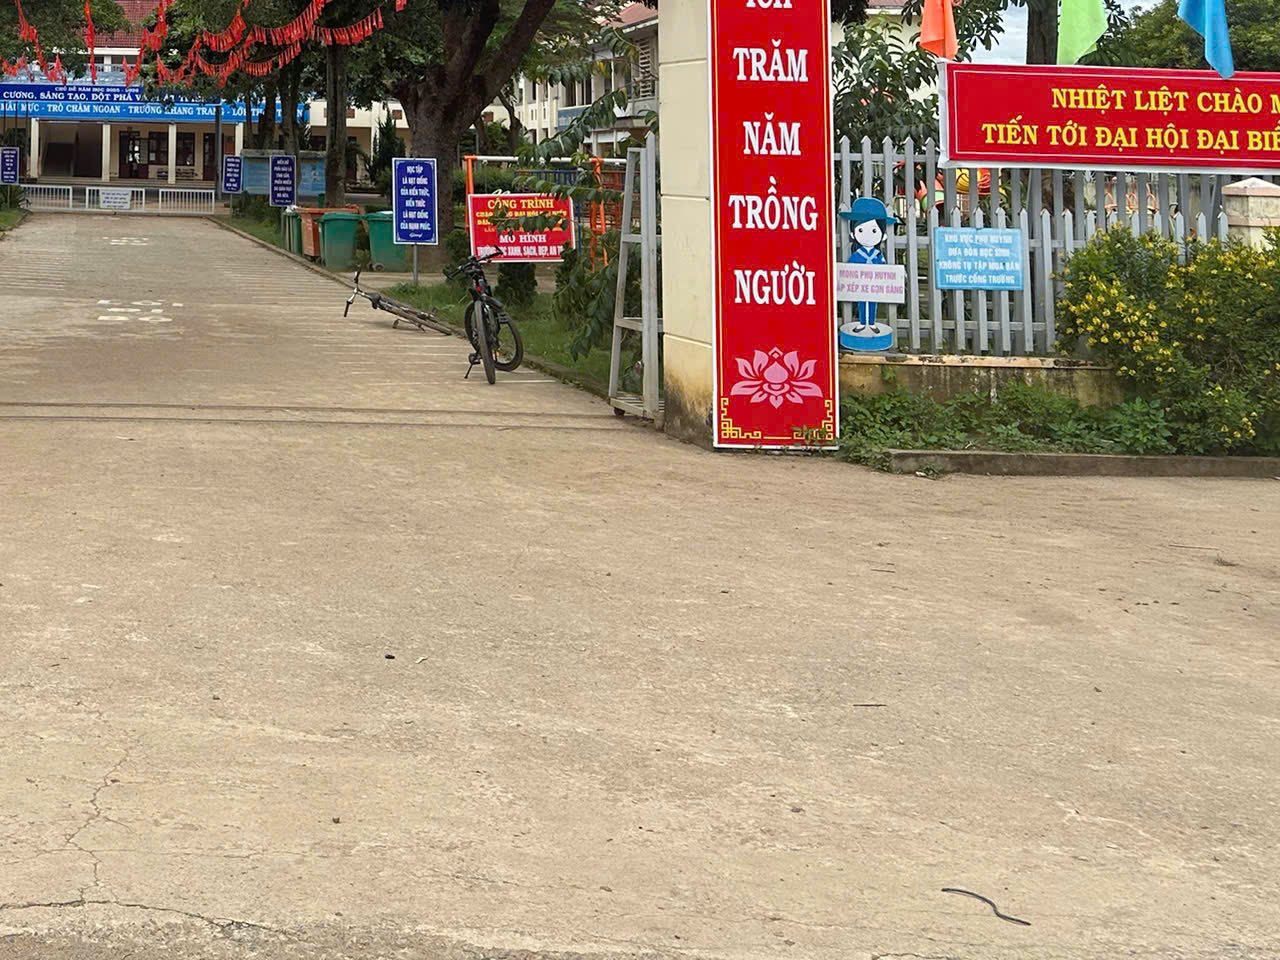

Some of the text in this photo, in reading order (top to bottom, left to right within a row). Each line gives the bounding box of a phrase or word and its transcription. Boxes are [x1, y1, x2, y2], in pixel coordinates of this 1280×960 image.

[732, 38, 809, 82] TRĂM
[1051, 83, 1127, 115] NHIỆT
[1134, 85, 1190, 116] LIỆT
[1197, 87, 1263, 114] CHÀO
[743, 111, 802, 156] NĂM
[981, 114, 1039, 145] TIẾN
[1046, 120, 1088, 146] TỚI
[1095, 126, 1139, 152] ĐẠI
[1145, 123, 1190, 154] HỘI
[1197, 129, 1240, 155] ĐẠI
[487, 197, 554, 209] CÔNG TRÌNH
[728, 175, 819, 231] TRỒNG
[519, 232, 547, 243] HÌNH
[734, 260, 816, 305] NGƯỜI
[836, 281, 846, 292] ẮP
[860, 284, 869, 294] XE
